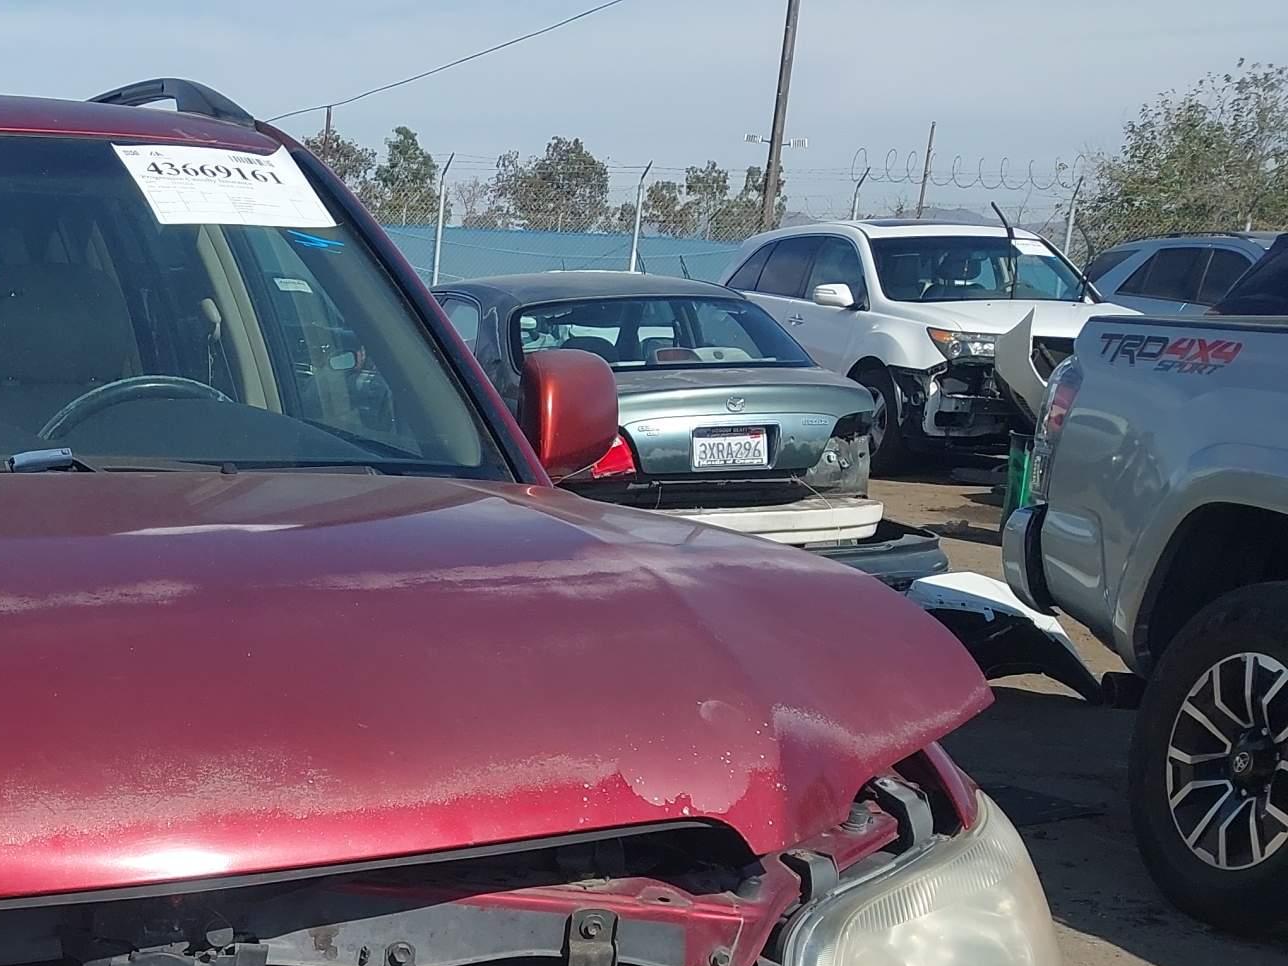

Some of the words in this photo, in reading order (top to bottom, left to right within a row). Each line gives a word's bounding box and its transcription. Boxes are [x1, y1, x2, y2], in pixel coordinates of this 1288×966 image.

[146, 161, 284, 185] 43669161
[1100, 333, 1169, 366] TRD
[1153, 359, 1225, 375] SPORT
[699, 440, 761, 460] 3XRA296
